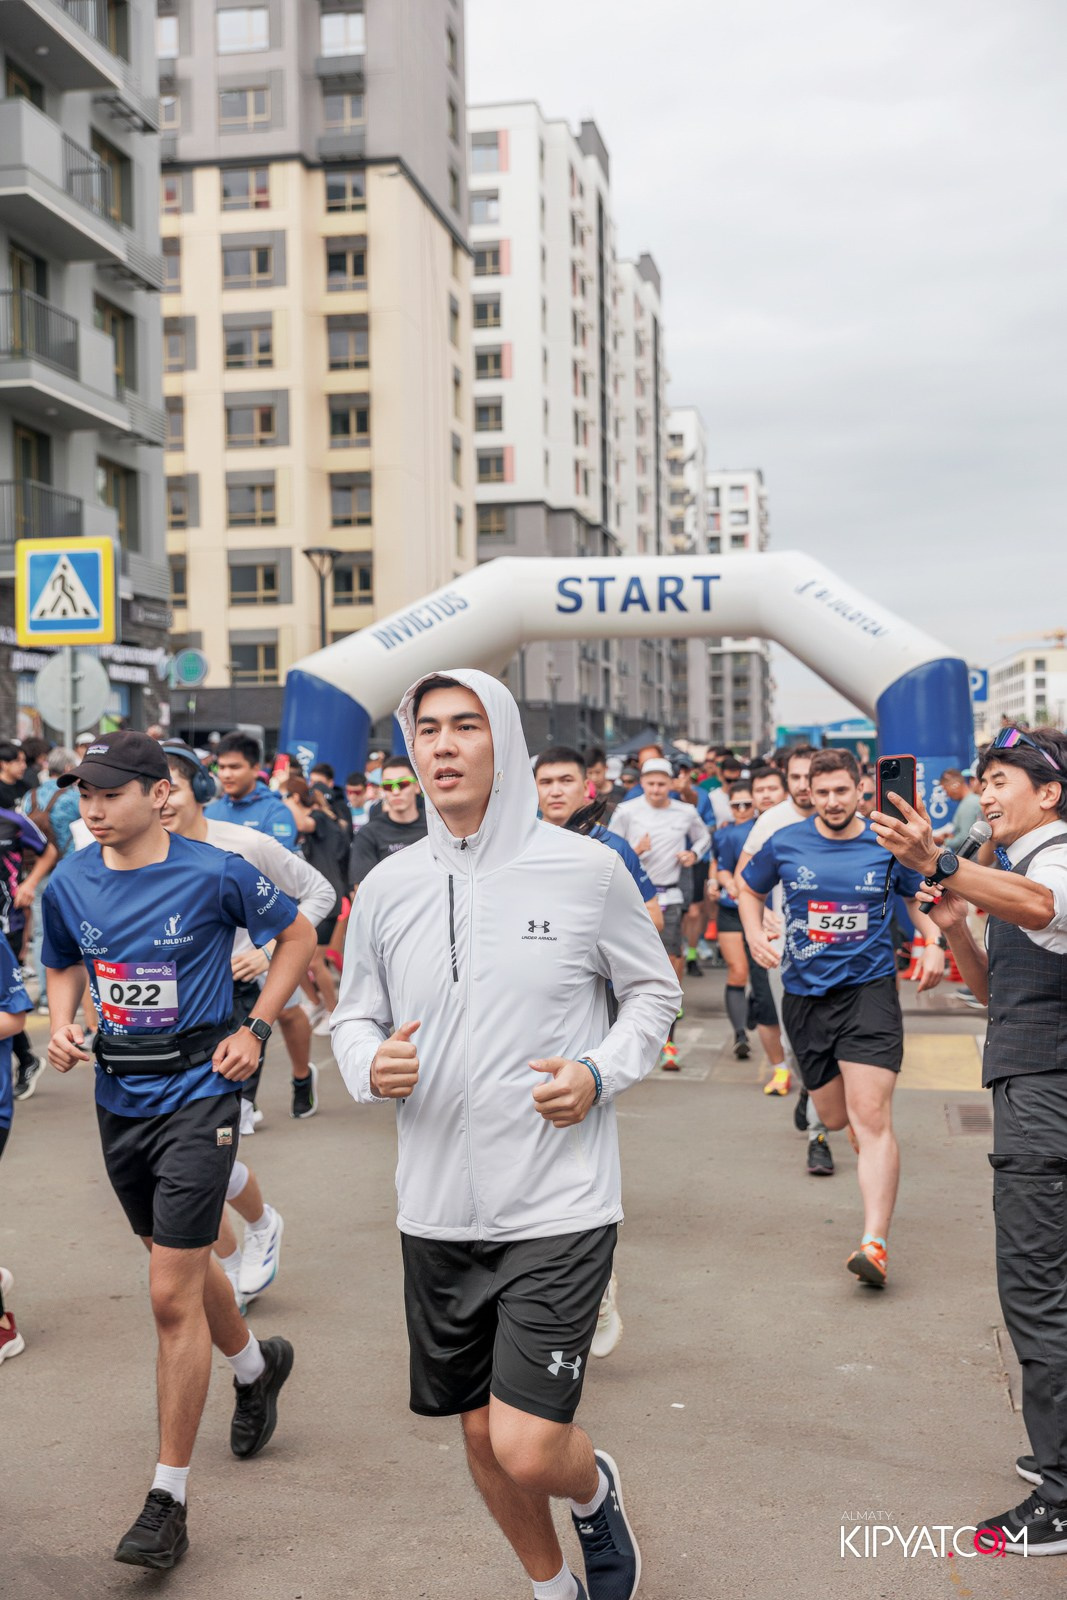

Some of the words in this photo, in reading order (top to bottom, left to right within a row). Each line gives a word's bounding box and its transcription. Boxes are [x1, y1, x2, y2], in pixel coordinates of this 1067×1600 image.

[556, 575, 720, 614] START
[373, 592, 468, 650] INVICTUS
[257, 894, 279, 915] Dream
[819, 916, 858, 930] 545
[162, 935, 194, 945] JULDYZAI
[98, 963, 106, 972] 10
[110, 983, 161, 1006] 022
